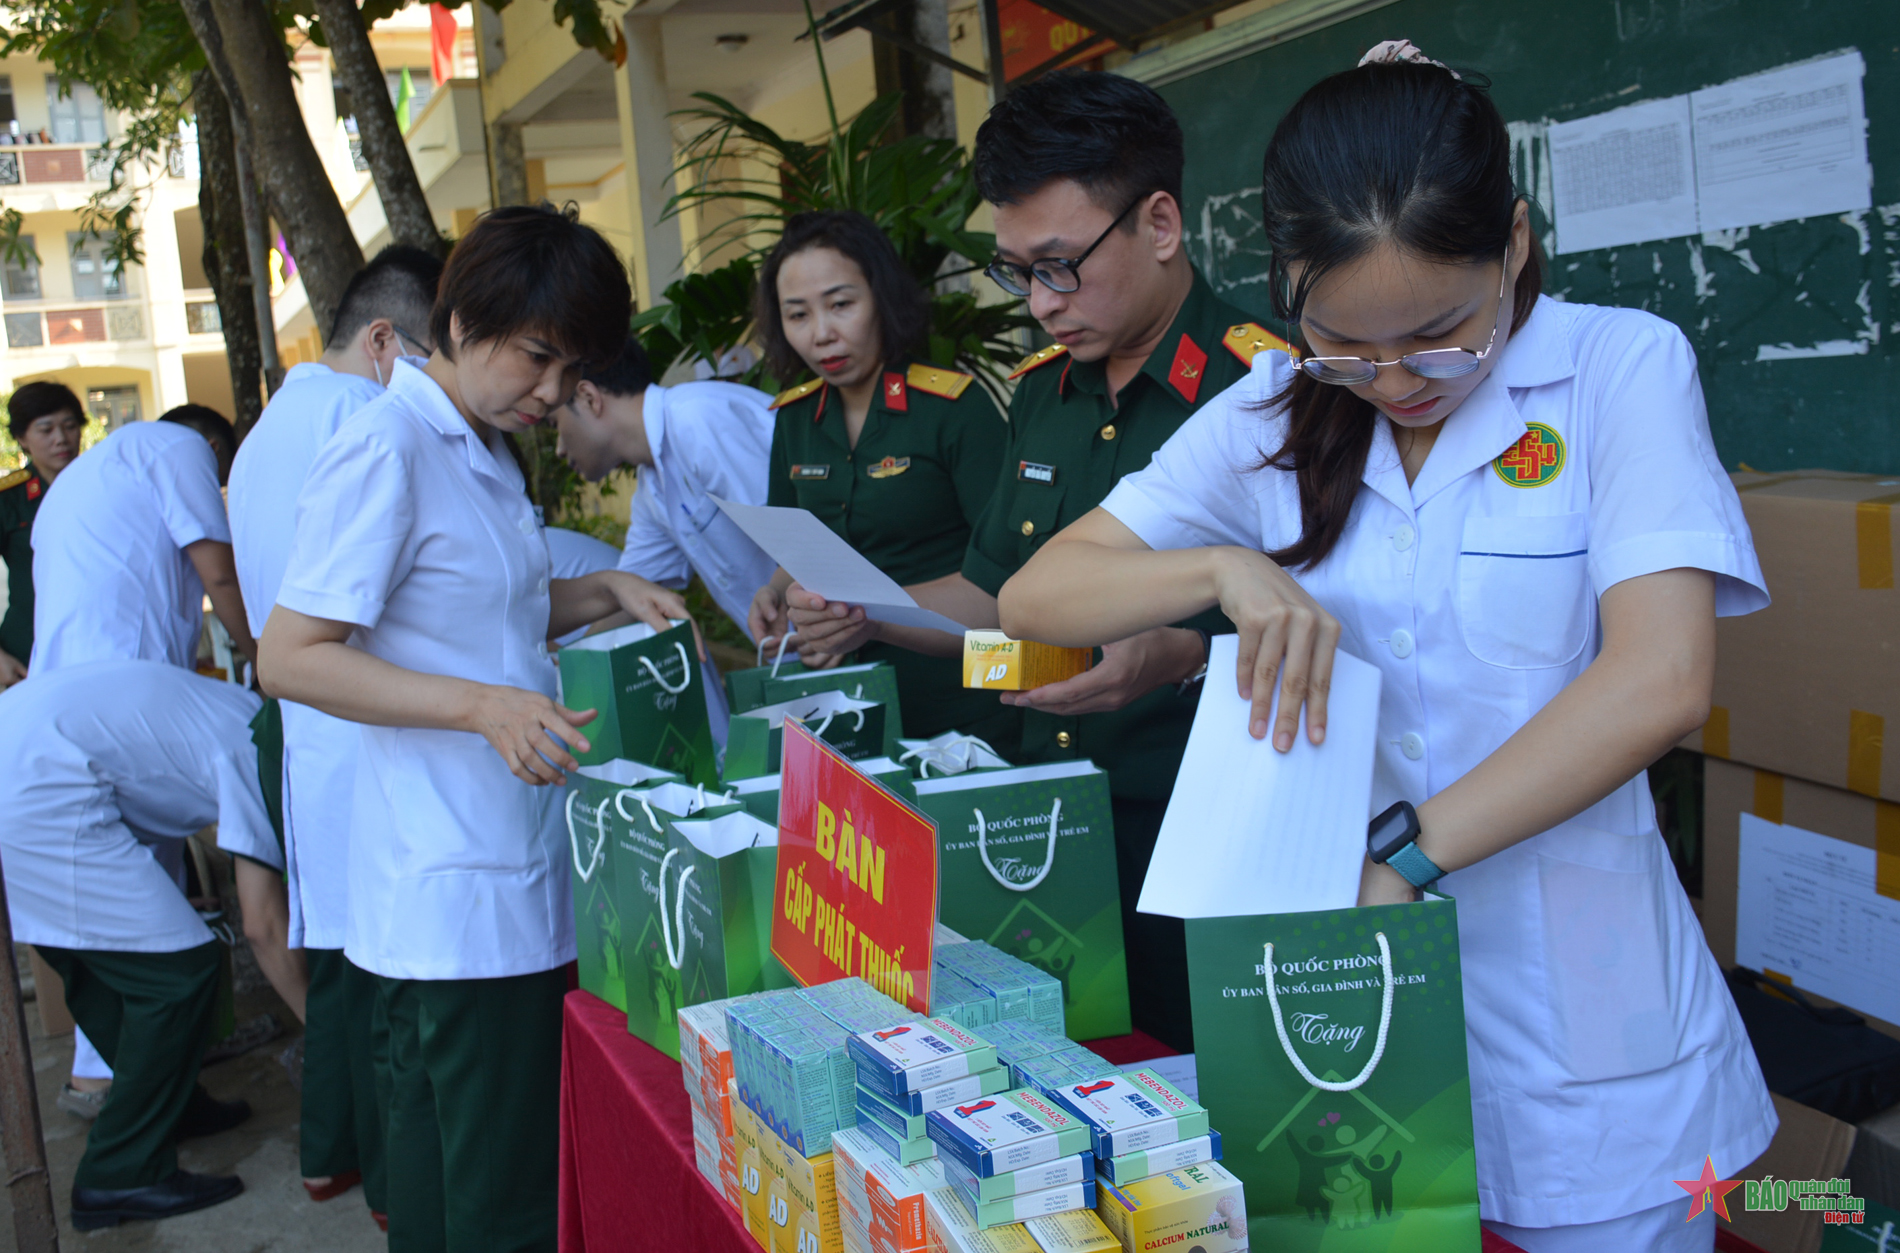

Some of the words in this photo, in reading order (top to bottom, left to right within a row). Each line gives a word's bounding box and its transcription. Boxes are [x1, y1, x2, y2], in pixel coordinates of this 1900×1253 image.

[1050, 20, 1090, 51] QU
[970, 640, 1000, 652] Vitamin
[1001, 642, 1014, 653] A-D
[985, 663, 1008, 683] AD
[987, 815, 1022, 833] QUỐC
[815, 799, 886, 906] BÀN
[784, 860, 813, 935] CẤP
[814, 893, 856, 977] PHÁT
[859, 931, 914, 1011] THUỐC
[1281, 955, 1330, 977] QUỐC
[1222, 984, 1238, 998] ỦY
[1240, 986, 1264, 998] BAN
[1267, 983, 1290, 997] ÂN
[1312, 982, 1333, 994] GIA
[1335, 977, 1365, 992] ĐÌNH
[1365, 975, 1382, 989] VÀ
[1384, 973, 1407, 987] RẺ
[1408, 974, 1427, 985] EM
[931, 1018, 979, 1047] MEBENDAZOL
[1290, 1011, 1366, 1054] Tặng
[1135, 1071, 1189, 1111] MEBENDAZOL
[1016, 1091, 1071, 1126] MEBENDAZOL
[742, 1163, 760, 1196] AD
[1166, 1172, 1191, 1191] oftgel
[1184, 1165, 1209, 1184] RAL
[769, 1193, 788, 1228] AD
[798, 1227, 818, 1253] AD
[1144, 1232, 1185, 1251] CALCIUM
[1186, 1220, 1229, 1240] NATURAL
